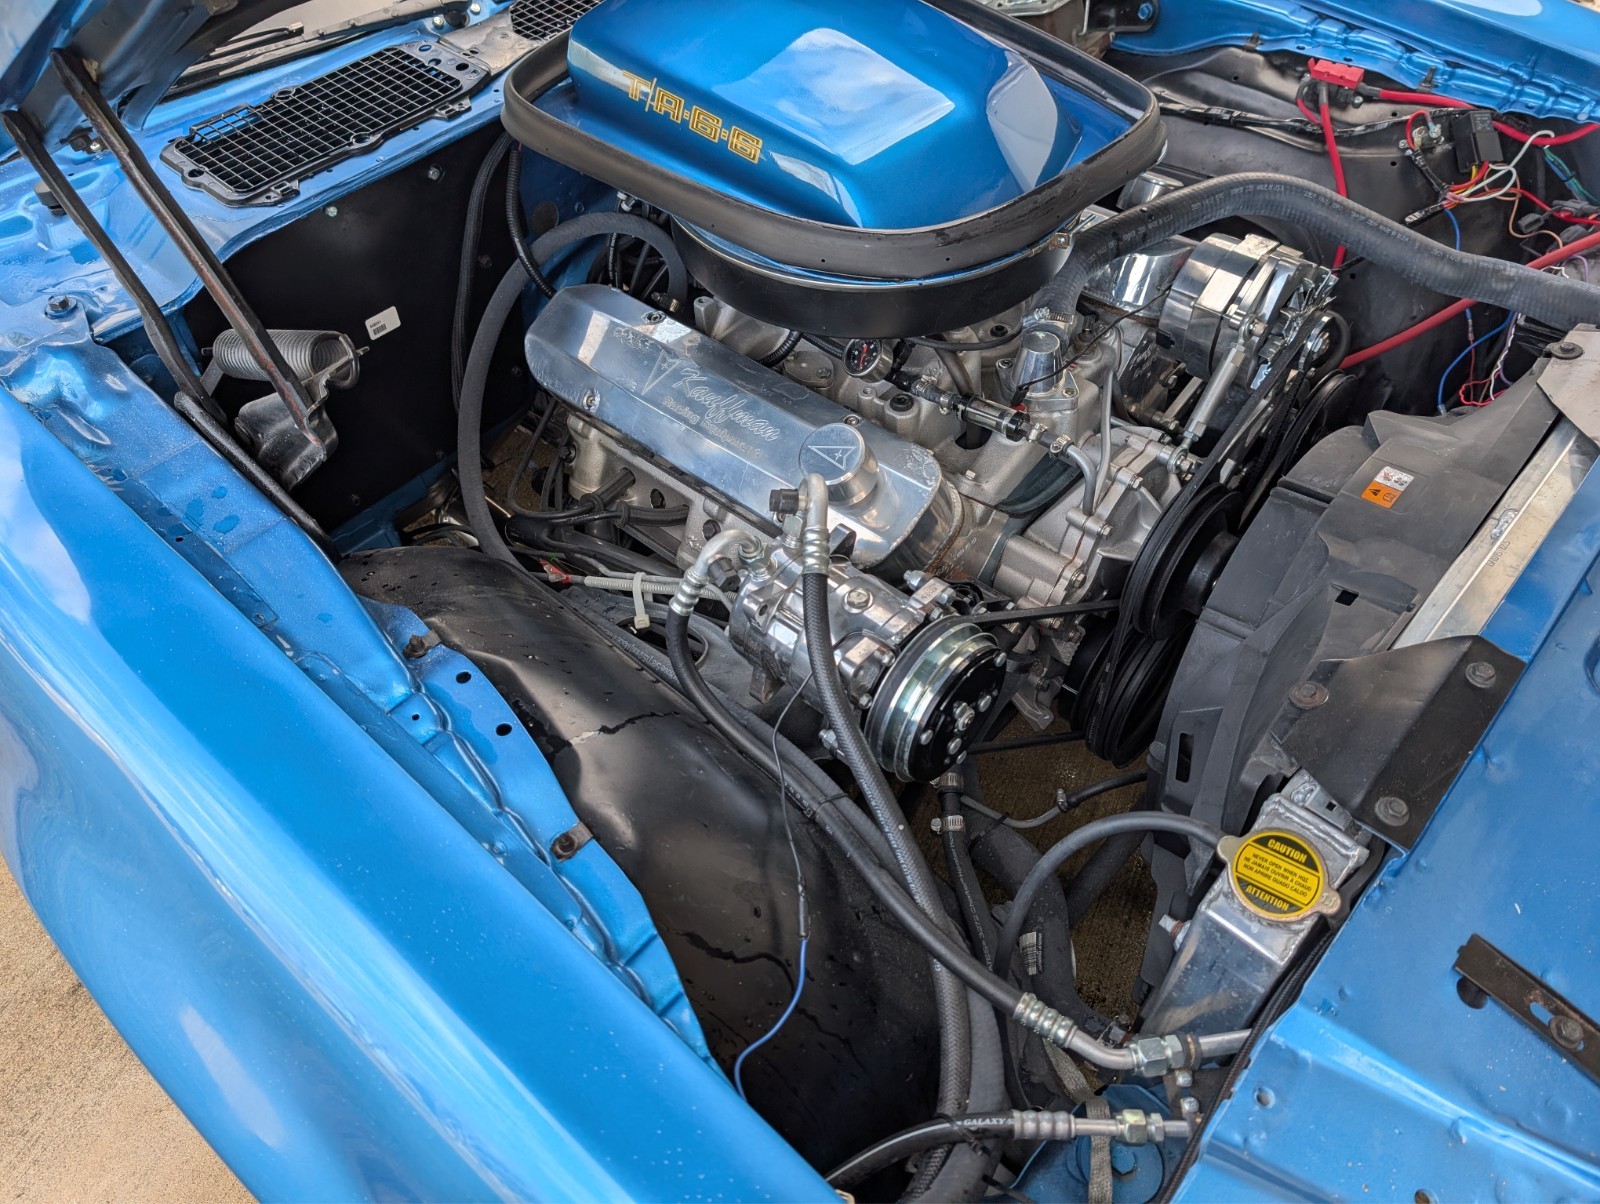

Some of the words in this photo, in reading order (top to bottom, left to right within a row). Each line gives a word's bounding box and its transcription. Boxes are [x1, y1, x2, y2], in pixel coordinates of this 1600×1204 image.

[1267, 839, 1307, 863] CAUTION
[1251, 852, 1268, 863] NEVER
[1268, 860, 1282, 870] OPEN
[1282, 867, 1297, 877] WHEN
[1251, 860, 1270, 871] JAMAIS
[1294, 879, 1312, 891] CHAUD
[1242, 863, 1254, 871] NON
[1253, 868, 1271, 879] APRIRE
[1289, 885, 1307, 897] CALDO
[1245, 884, 1289, 911] ATTENTION
[963, 1118, 1006, 1126] GALAXY
